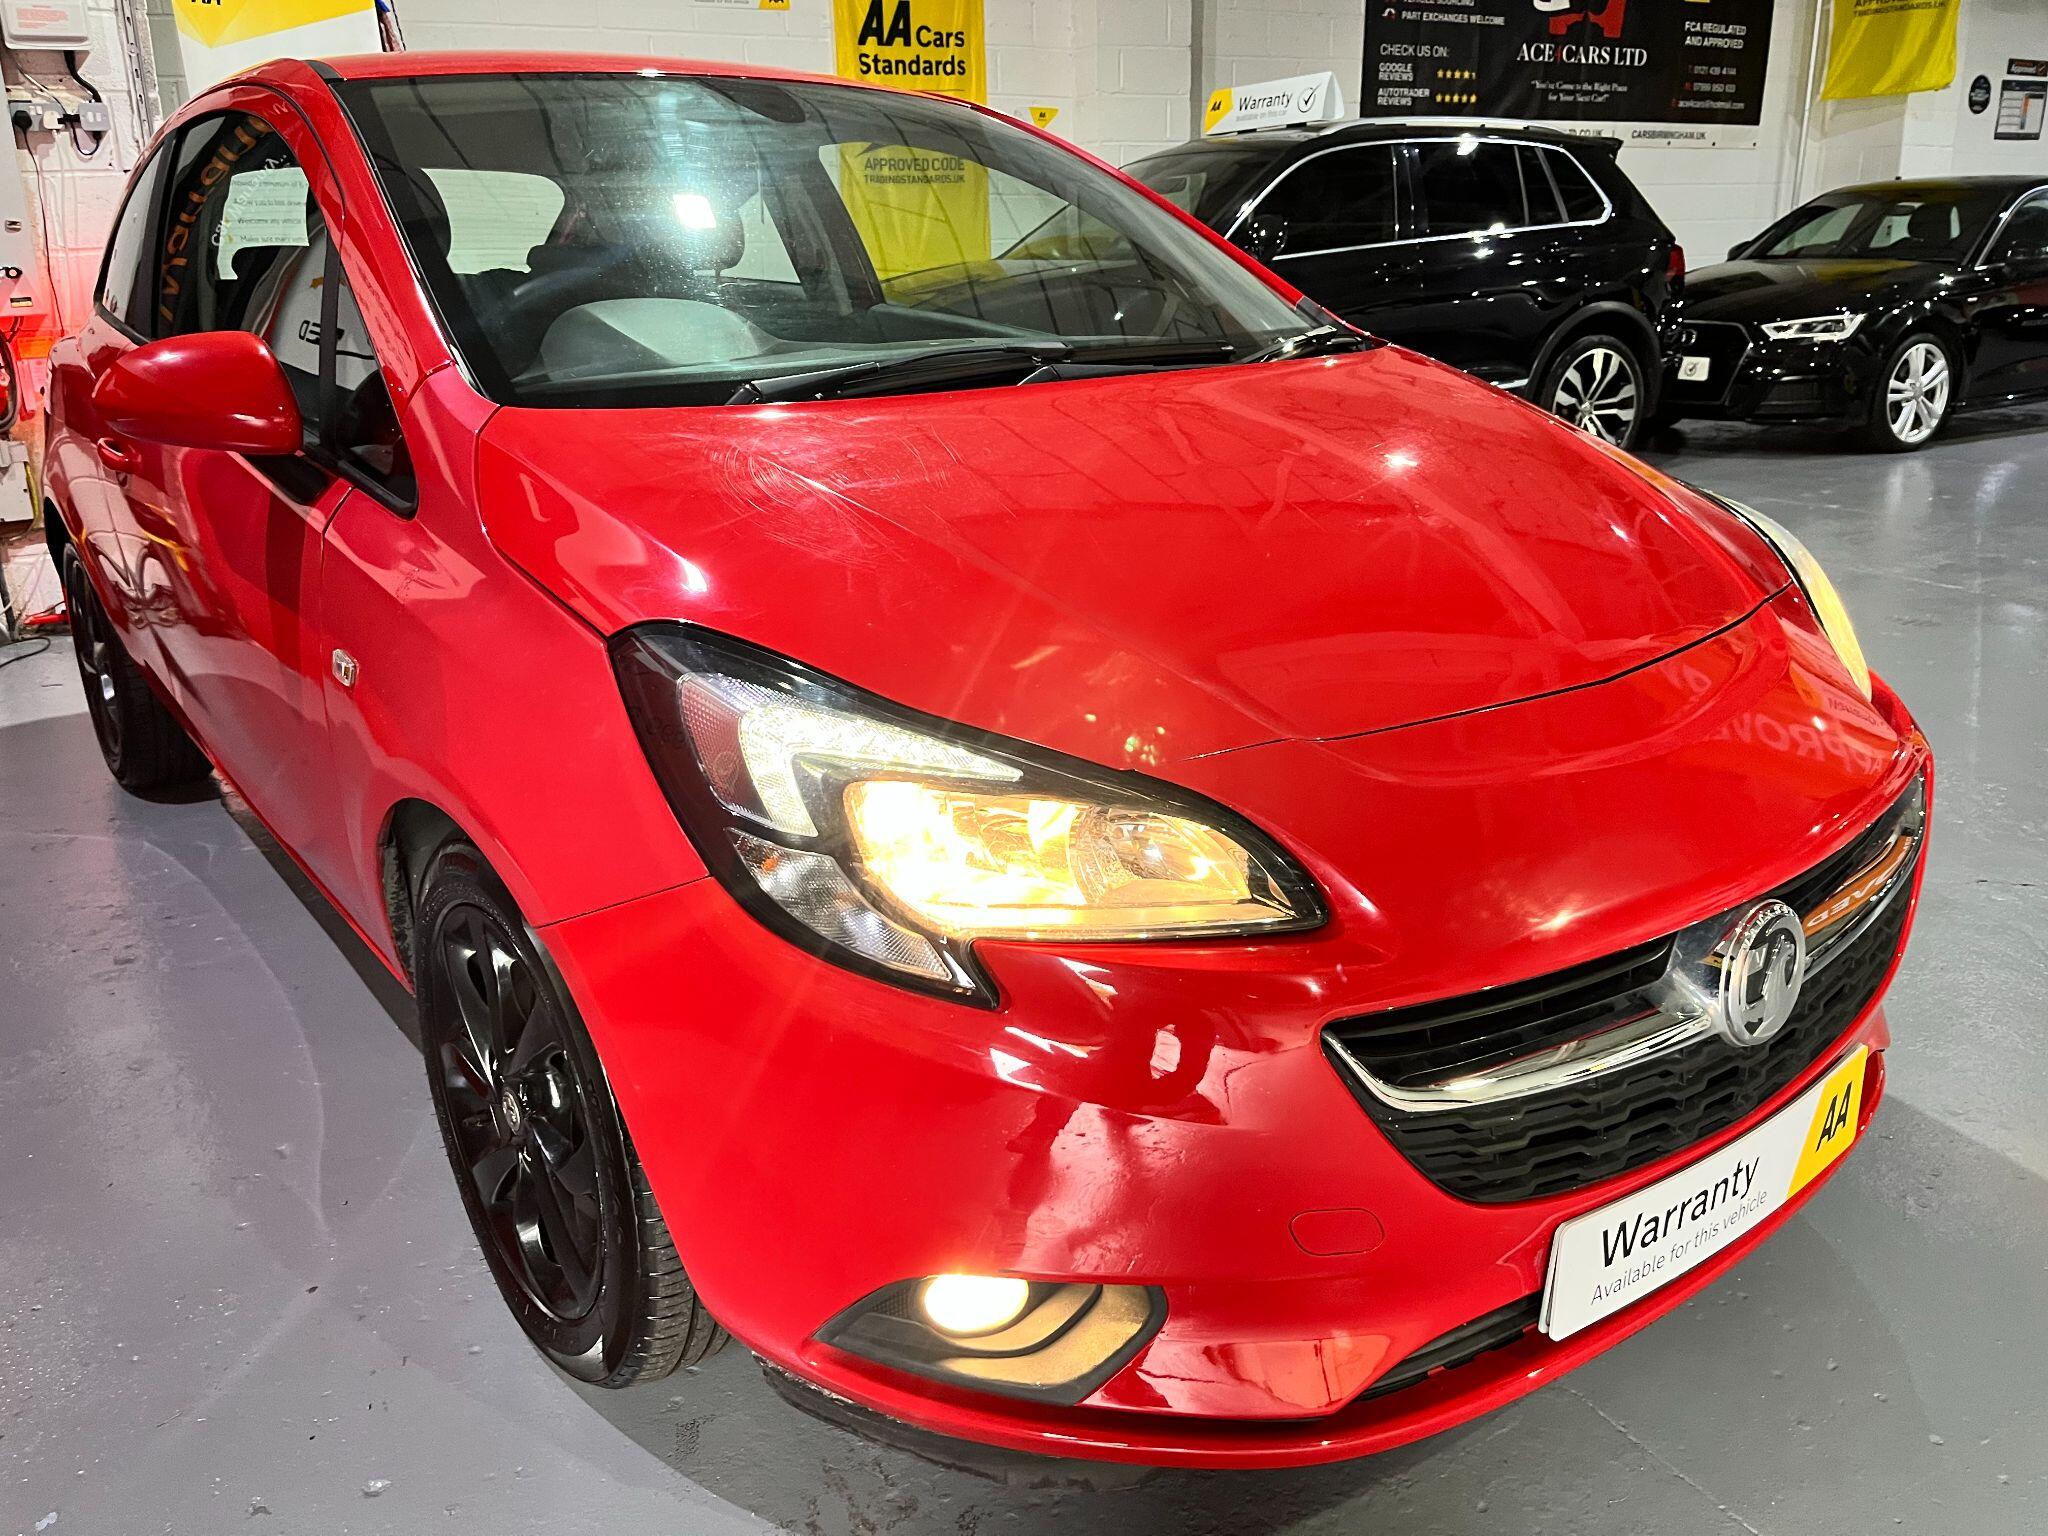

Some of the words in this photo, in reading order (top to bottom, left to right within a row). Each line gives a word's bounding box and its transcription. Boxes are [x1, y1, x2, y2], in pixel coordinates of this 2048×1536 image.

[858, 0, 912, 47] AA
[916, 25, 965, 48] Cars
[1401, 11, 1421, 20] PART
[1422, 12, 1468, 23] EXCHANGES
[1469, 15, 1505, 25] WELCOME
[1685, 21, 1701, 32] FCA
[1702, 22, 1747, 36] REGULATED
[1685, 36, 1702, 47] AND
[1703, 37, 1744, 49] APPROVED
[1380, 43, 1415, 57] CHECK
[1417, 45, 1431, 58] US
[1614, 47, 1648, 67] LTD
[859, 53, 966, 76] Standards
[1379, 63, 1413, 73] GOOGLE
[1378, 72, 1413, 82] REVIEWS
[1377, 87, 1431, 98] AUTOTRADER
[1210, 101, 1223, 112] AA
[1239, 91, 1293, 111] Warranty
[1377, 97, 1413, 106] REVIEWS
[864, 157, 930, 172] APPROVED
[931, 157, 965, 172] CODE
[1815, 1080, 1853, 1152] AA
[1602, 1155, 1760, 1268] Warranty
[1590, 1254, 1666, 1305] Available
[1669, 1239, 1692, 1264] for
[1692, 1221, 1720, 1250] this
[1722, 1188, 1768, 1231] vehicle
